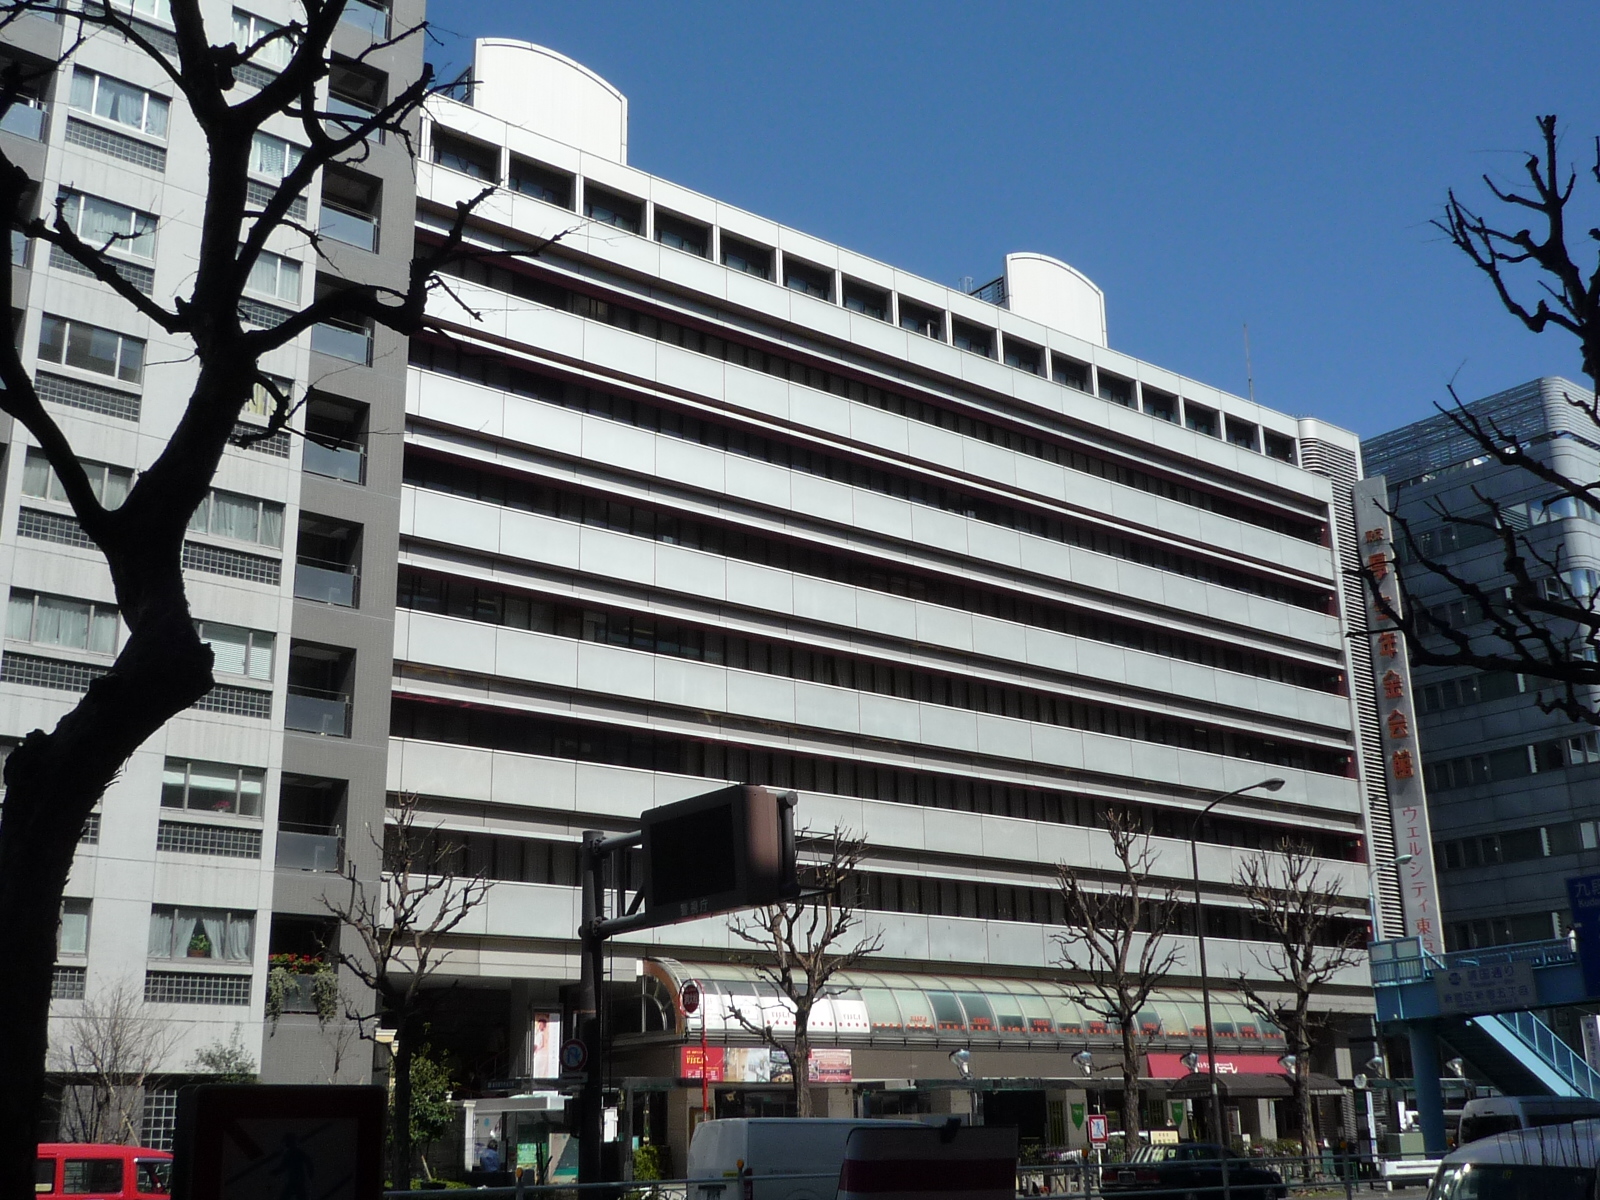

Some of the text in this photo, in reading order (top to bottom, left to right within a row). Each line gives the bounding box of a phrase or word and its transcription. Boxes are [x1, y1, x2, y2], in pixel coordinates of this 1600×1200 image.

[1402, 806, 1436, 955] ウェルシティ東京
